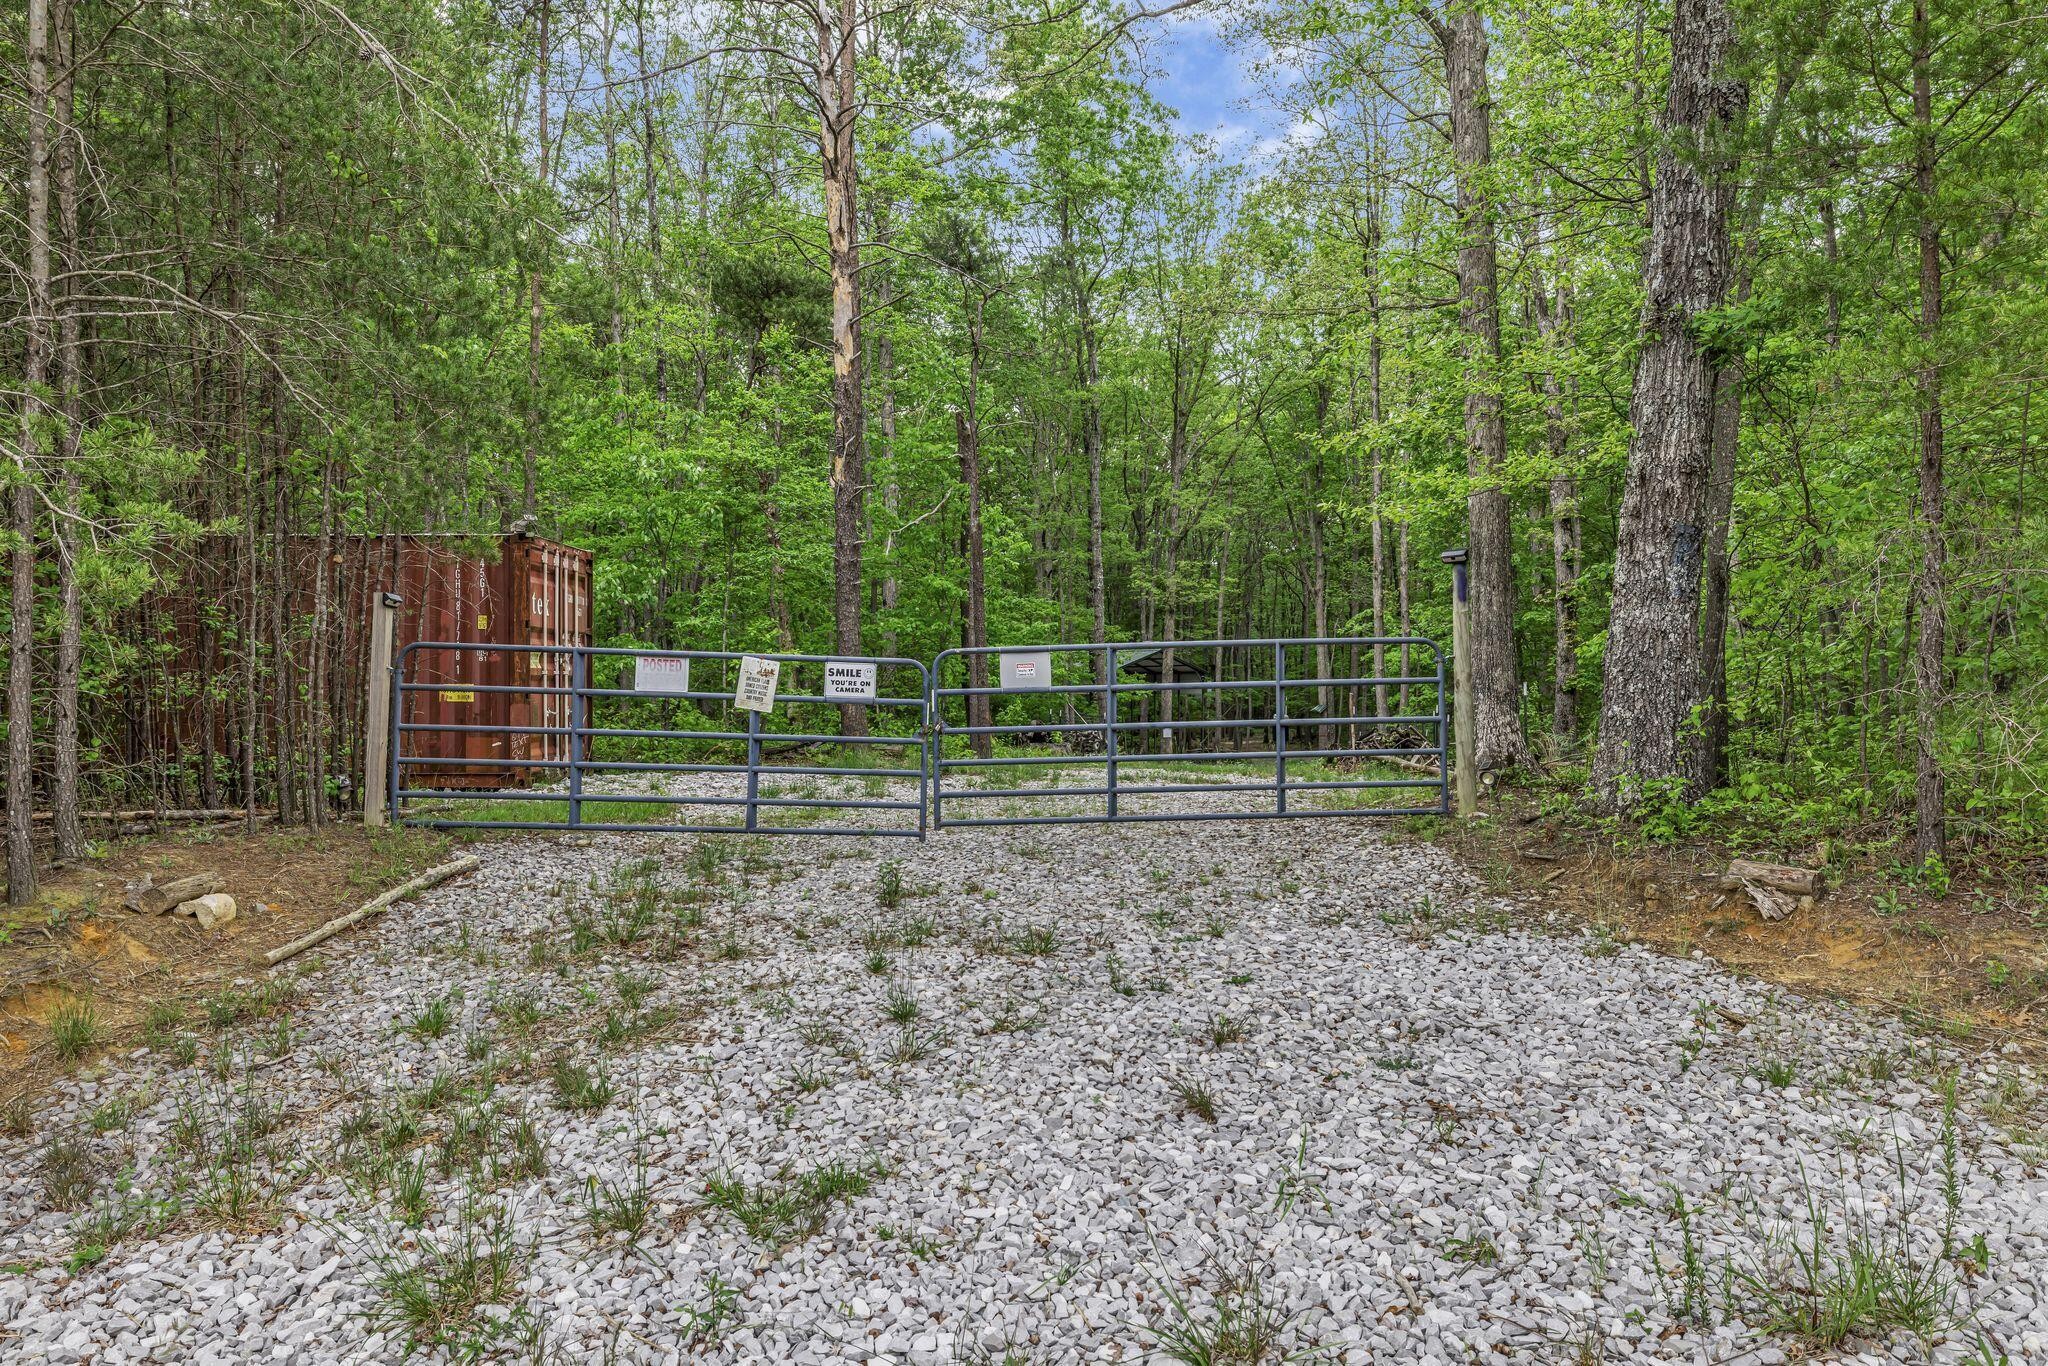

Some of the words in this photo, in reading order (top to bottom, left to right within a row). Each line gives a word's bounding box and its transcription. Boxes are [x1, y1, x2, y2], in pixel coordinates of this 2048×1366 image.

[642, 658, 682, 672] POSTED
[828, 667, 862, 677] SMILE
[835, 686, 865, 694] CAMERA
